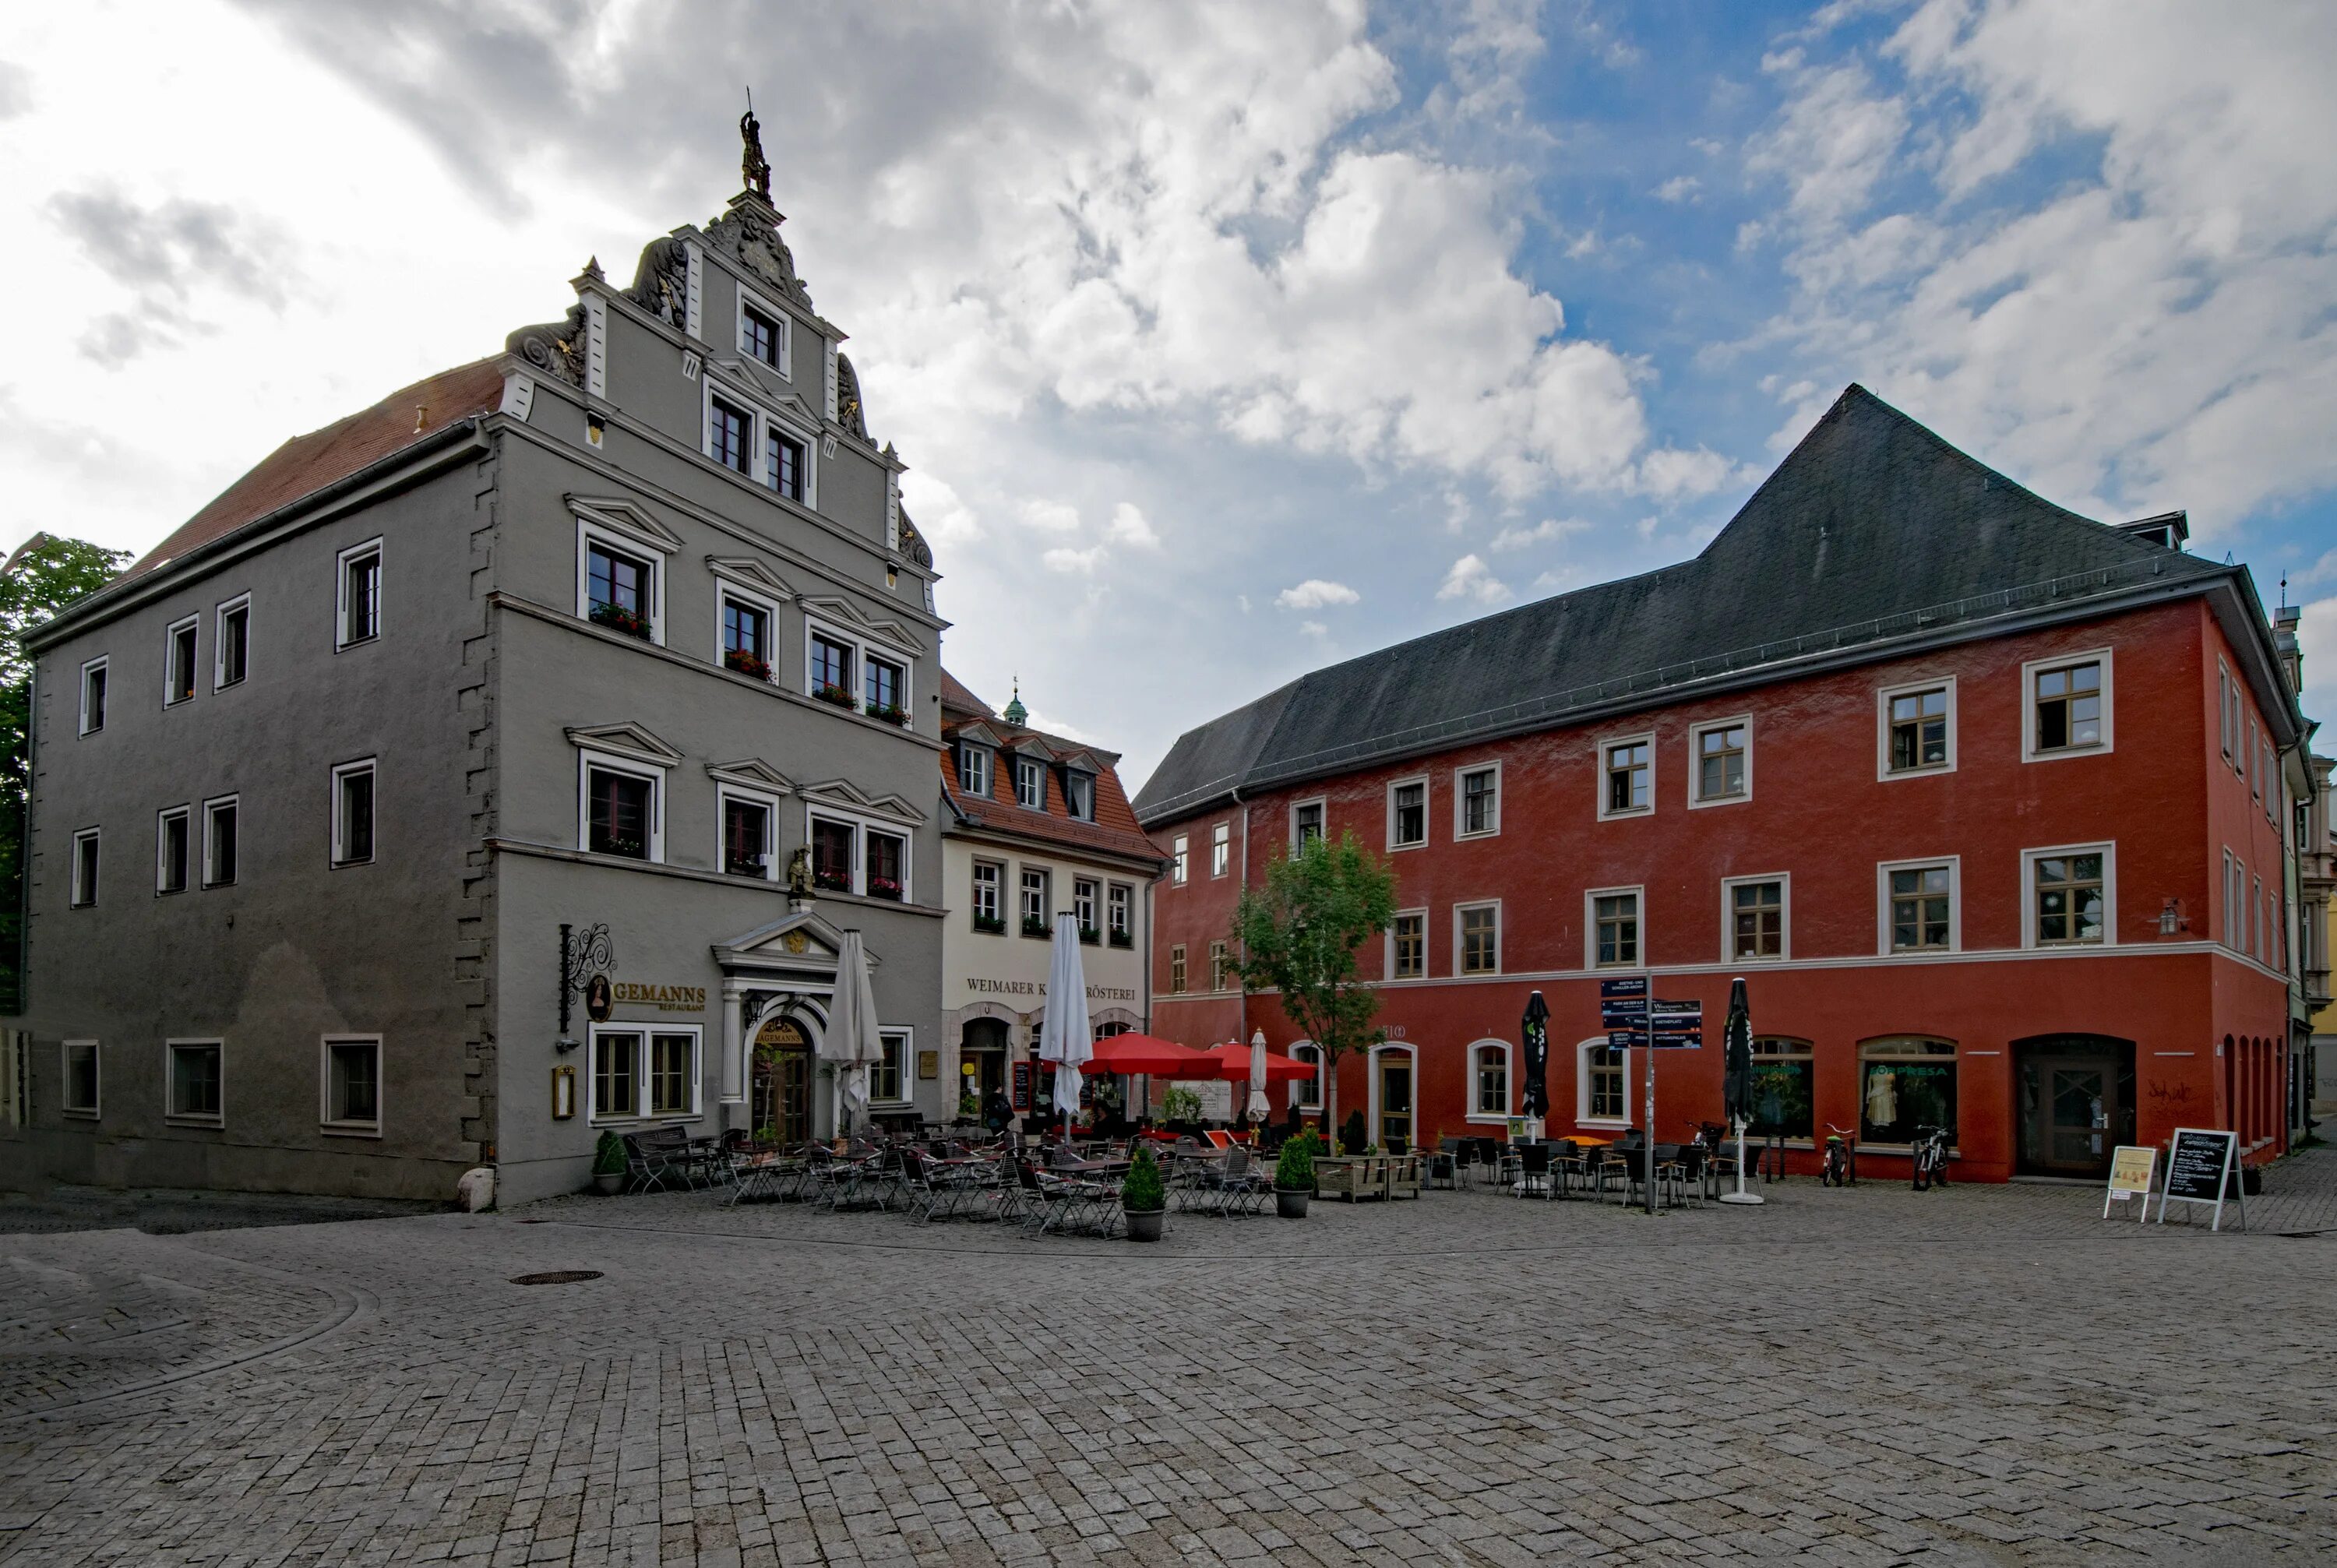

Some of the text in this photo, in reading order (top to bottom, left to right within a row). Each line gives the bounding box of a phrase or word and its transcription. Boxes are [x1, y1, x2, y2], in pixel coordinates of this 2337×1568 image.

[614, 982, 706, 1002] GEMANNS
[968, 978, 1135, 1000] WEIMARER KRÖSTEREI
[659, 1003, 705, 1012] RESTAURANT
